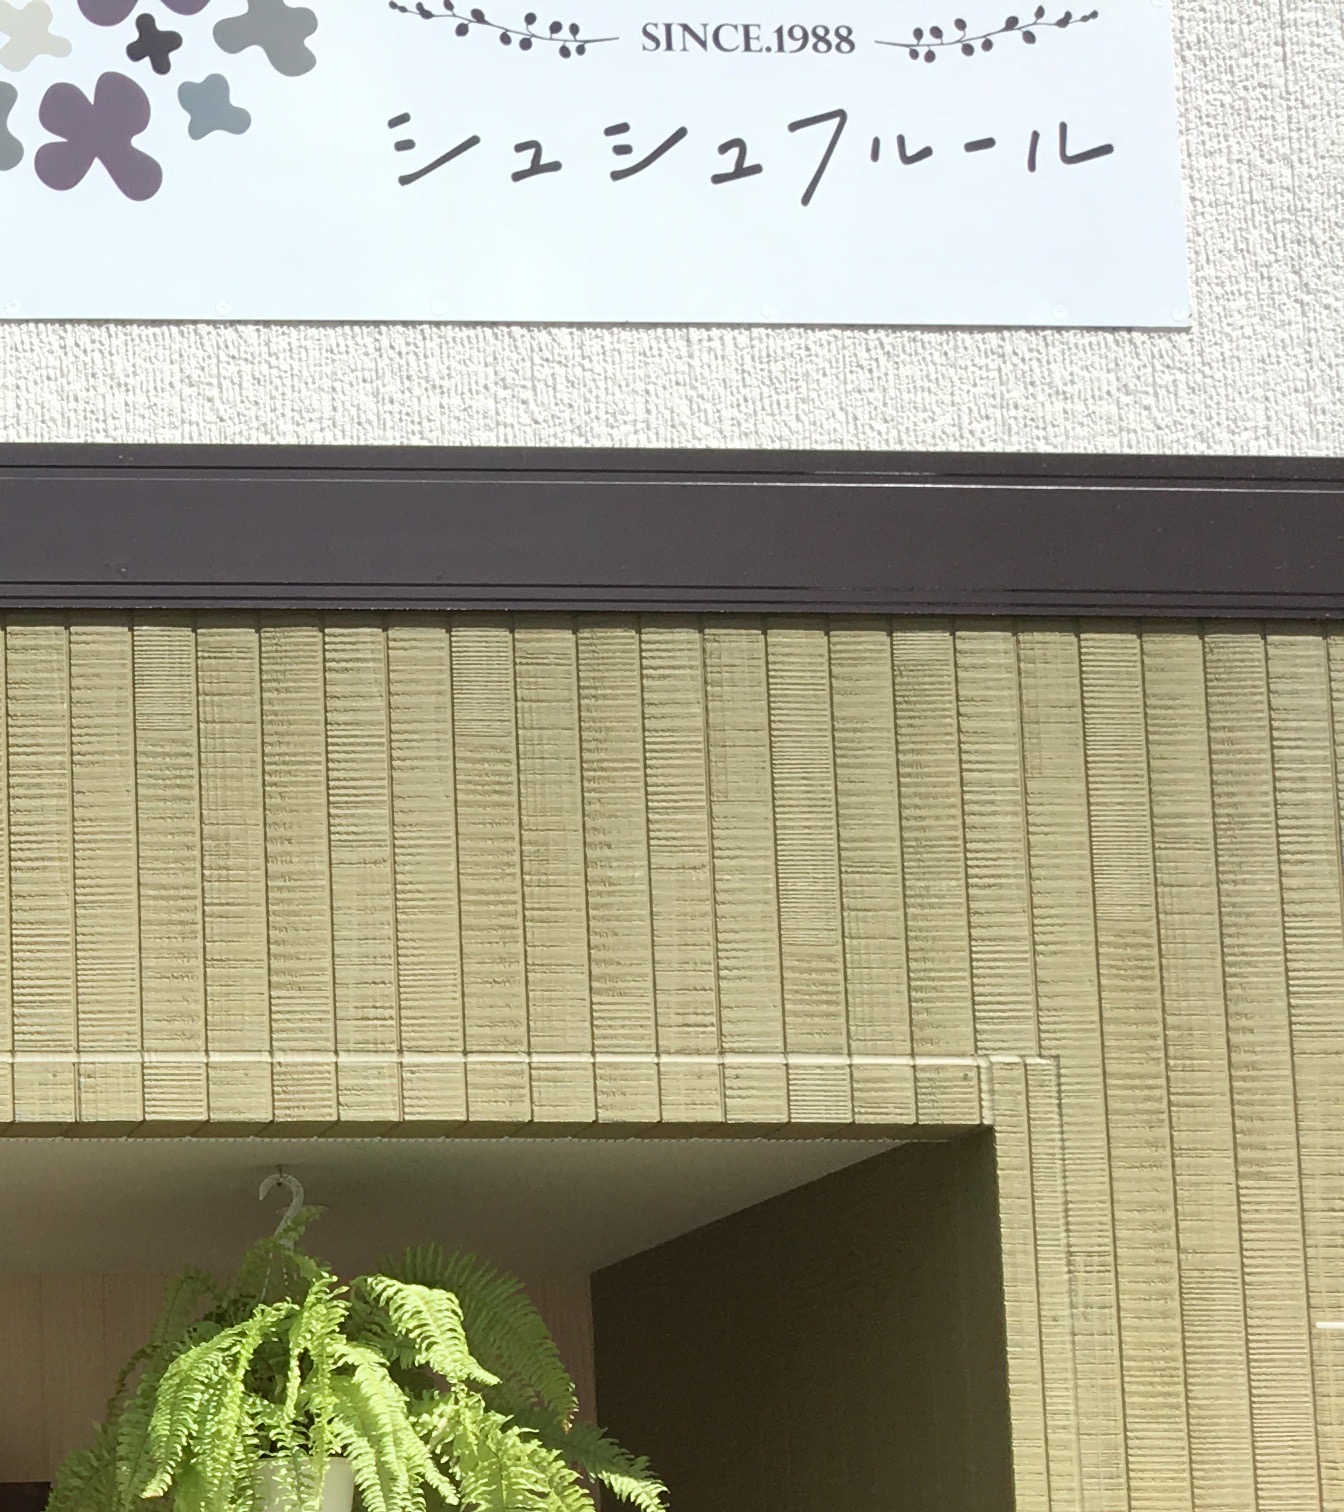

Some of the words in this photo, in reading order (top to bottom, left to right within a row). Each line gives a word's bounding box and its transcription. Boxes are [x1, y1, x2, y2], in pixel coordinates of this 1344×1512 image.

[640, 22, 857, 55] SINCE.1988
[387, 109, 1114, 206] シュシュフルール
